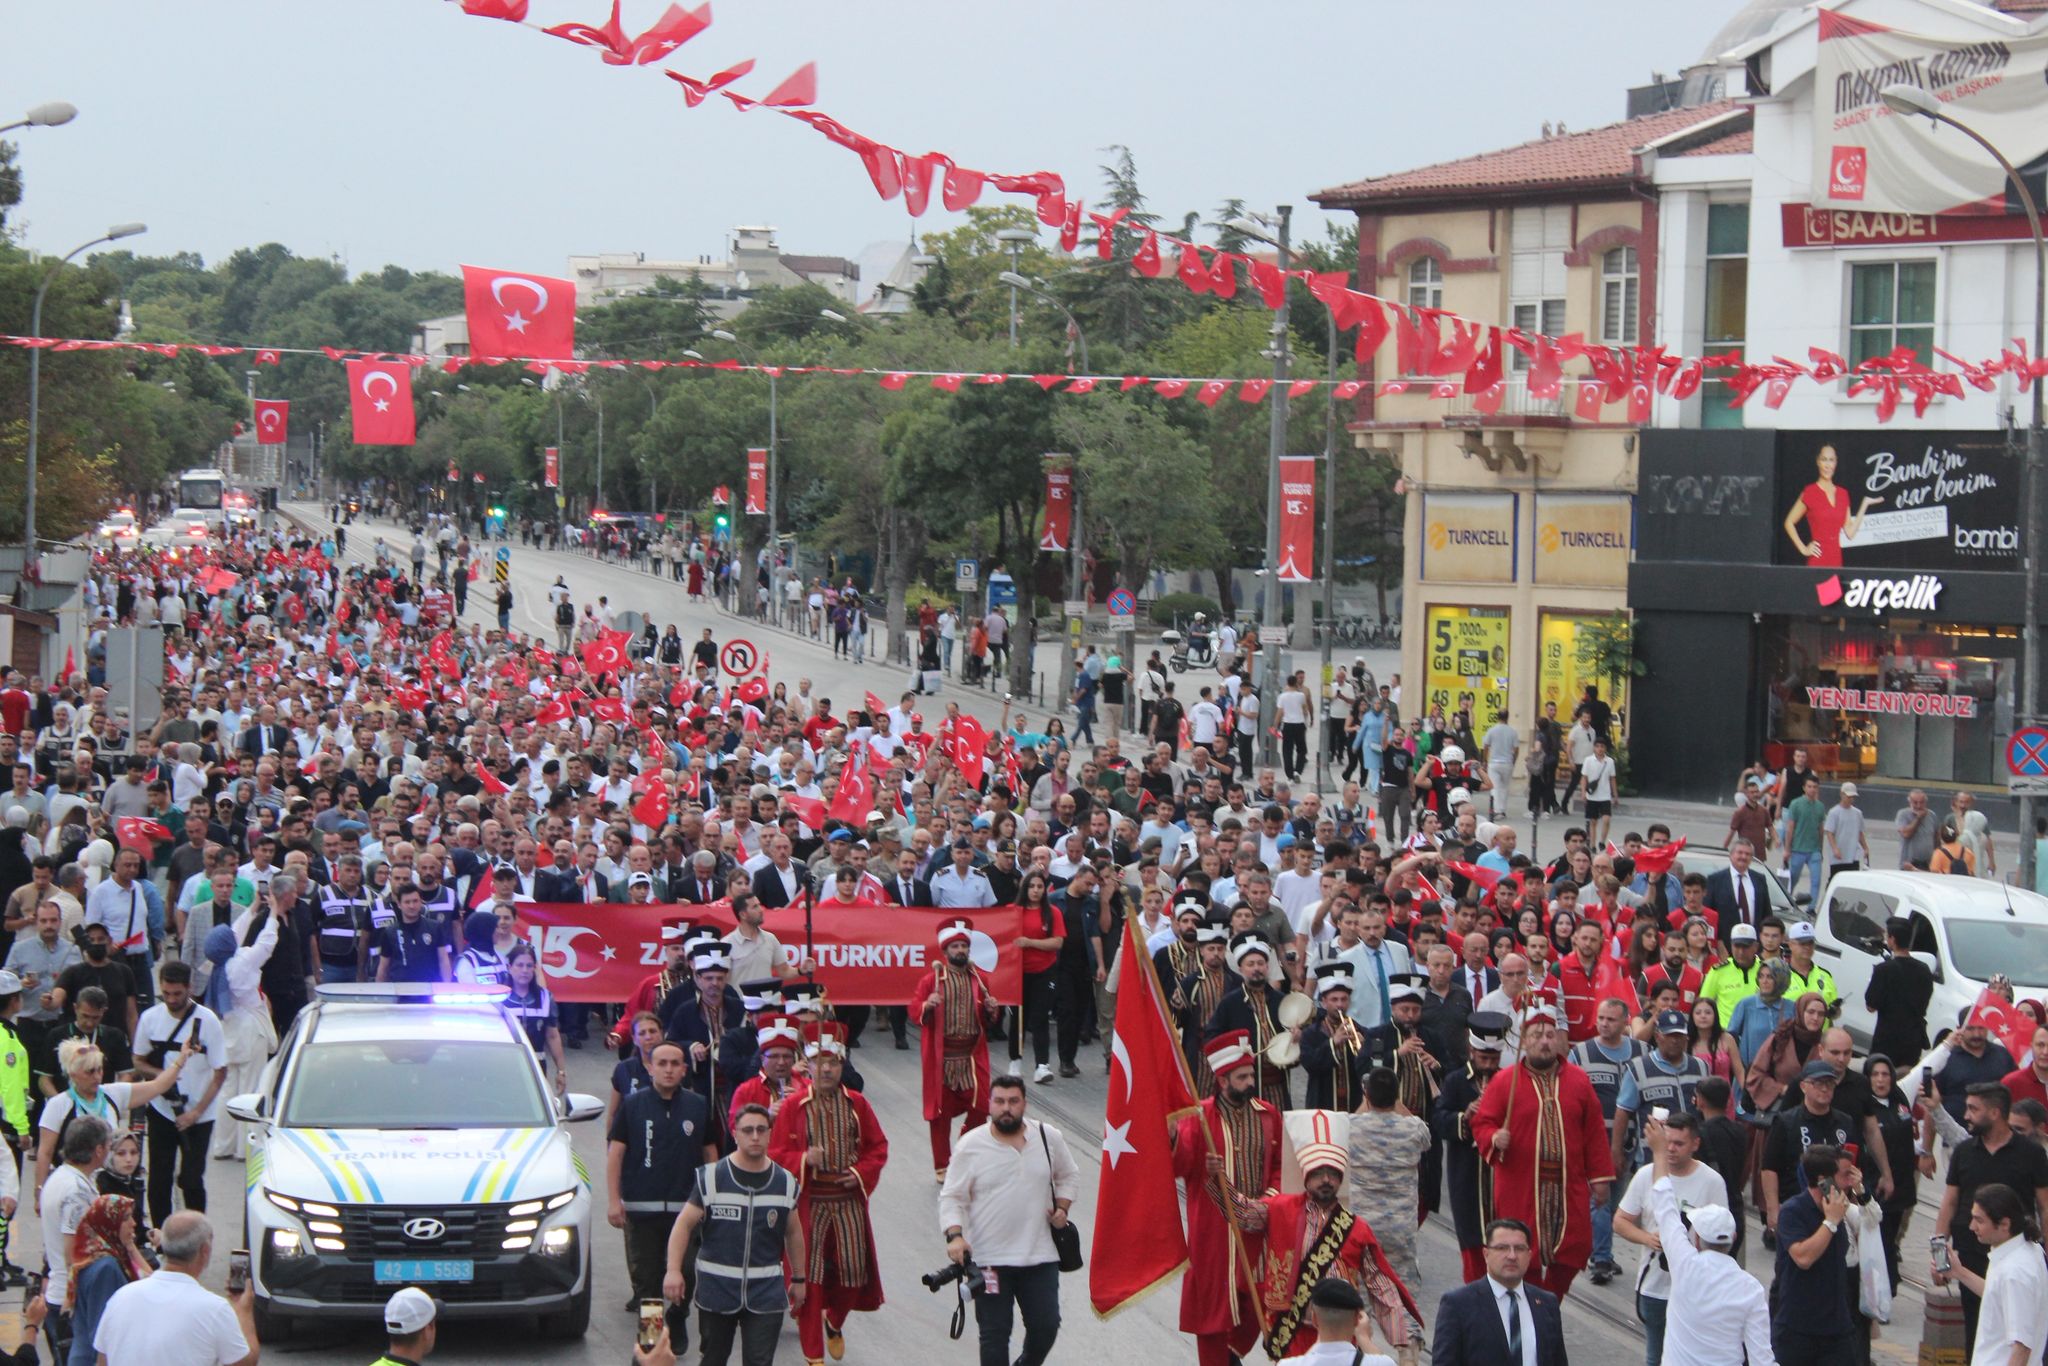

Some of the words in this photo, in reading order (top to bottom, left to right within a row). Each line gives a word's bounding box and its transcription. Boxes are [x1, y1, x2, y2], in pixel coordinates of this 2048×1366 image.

[1448, 529, 1510, 546] TURKCELL
[1560, 531, 1626, 548] TURKCELL
[1954, 524, 2019, 549] bambi
[963, 565, 971, 576] D
[1844, 574, 1943, 616] arçelik
[1435, 620, 1452, 653] 5
[1548, 643, 1562, 658] 18
[1433, 655, 1452, 671] GB
[1432, 689, 1449, 707] 48
[1486, 692, 1502, 708] 90
[811, 944, 925, 968] TÜRKİYE
[331, 1150, 416, 1161] TRAFİK
[427, 1150, 507, 1161] POLİSİ
[384, 1263, 402, 1279] 42
[414, 1263, 422, 1279] A
[434, 1262, 471, 1278] 5563
